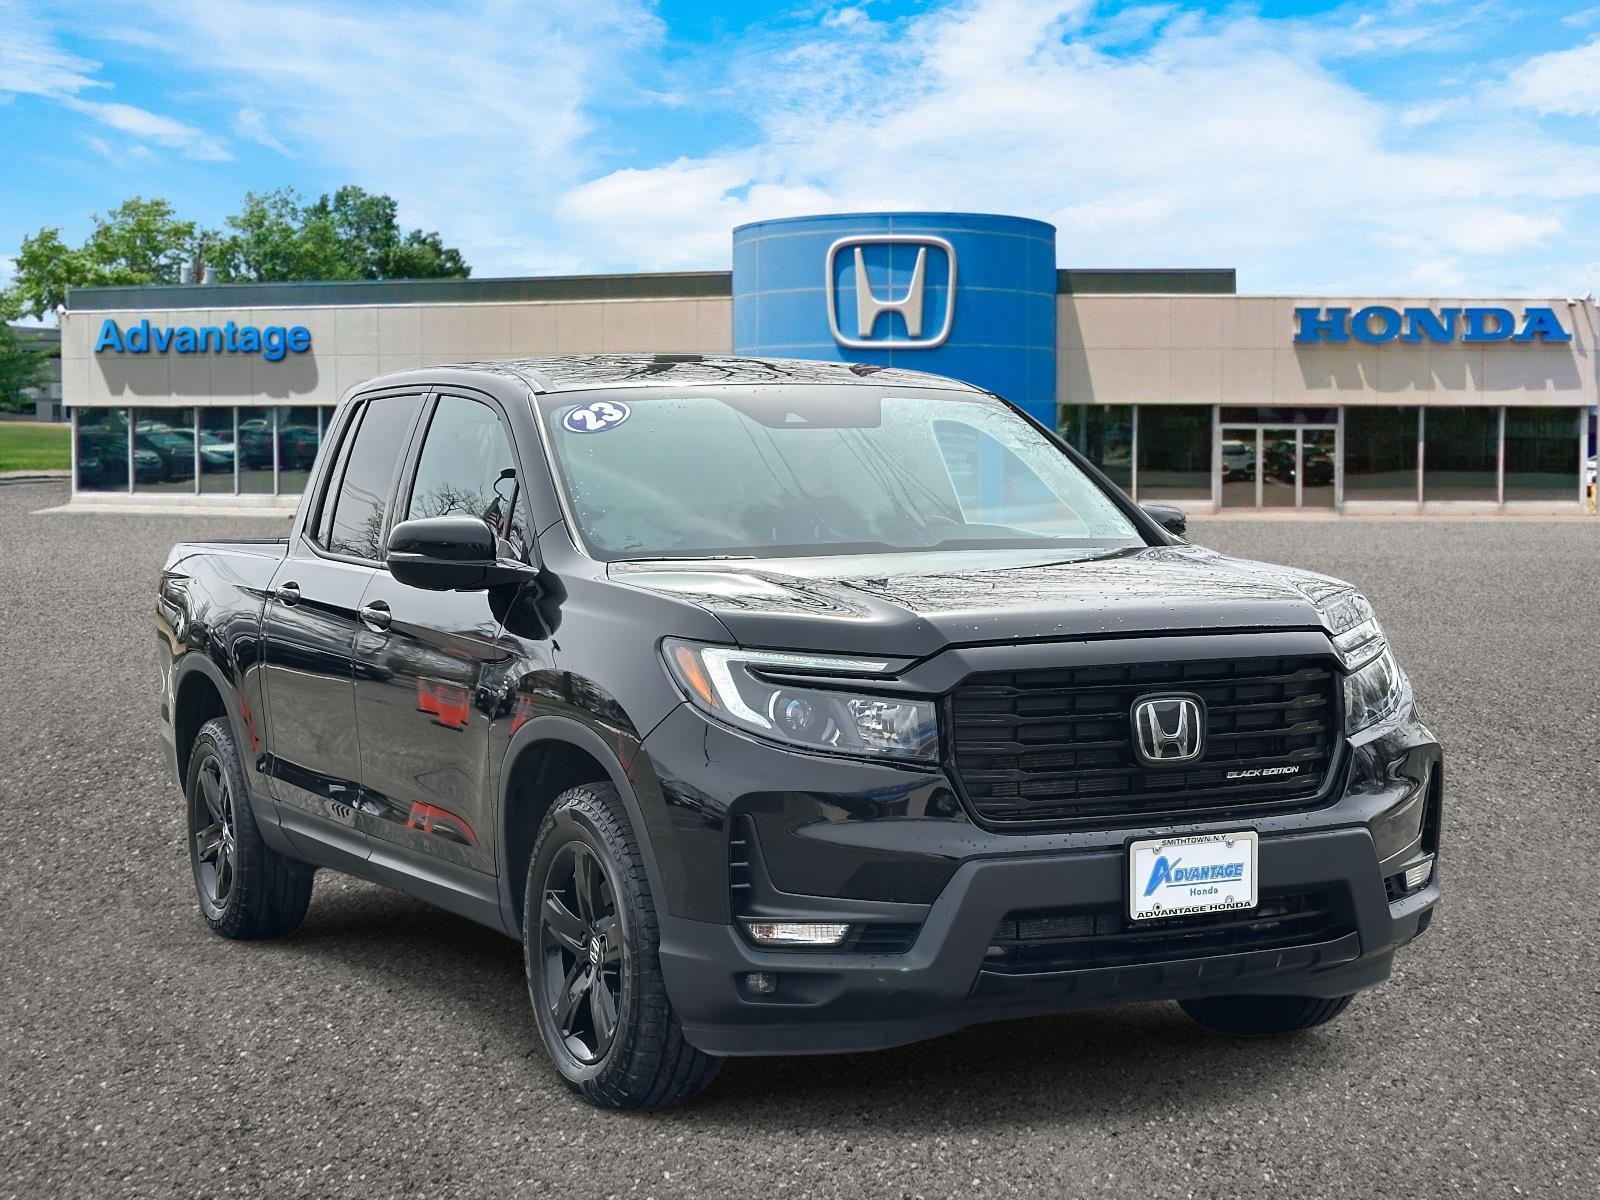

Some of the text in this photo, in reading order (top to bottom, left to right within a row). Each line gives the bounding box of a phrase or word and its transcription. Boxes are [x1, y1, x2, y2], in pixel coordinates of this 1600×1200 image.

[1294, 305, 1572, 343] HONDA
[95, 318, 311, 361] Advantage
[572, 402, 624, 430] 23
[1226, 765, 1300, 779] BLACK EDITION
[1189, 886, 1219, 897] Honda
[1136, 901, 1252, 919] ADVANTAGE HONDA
